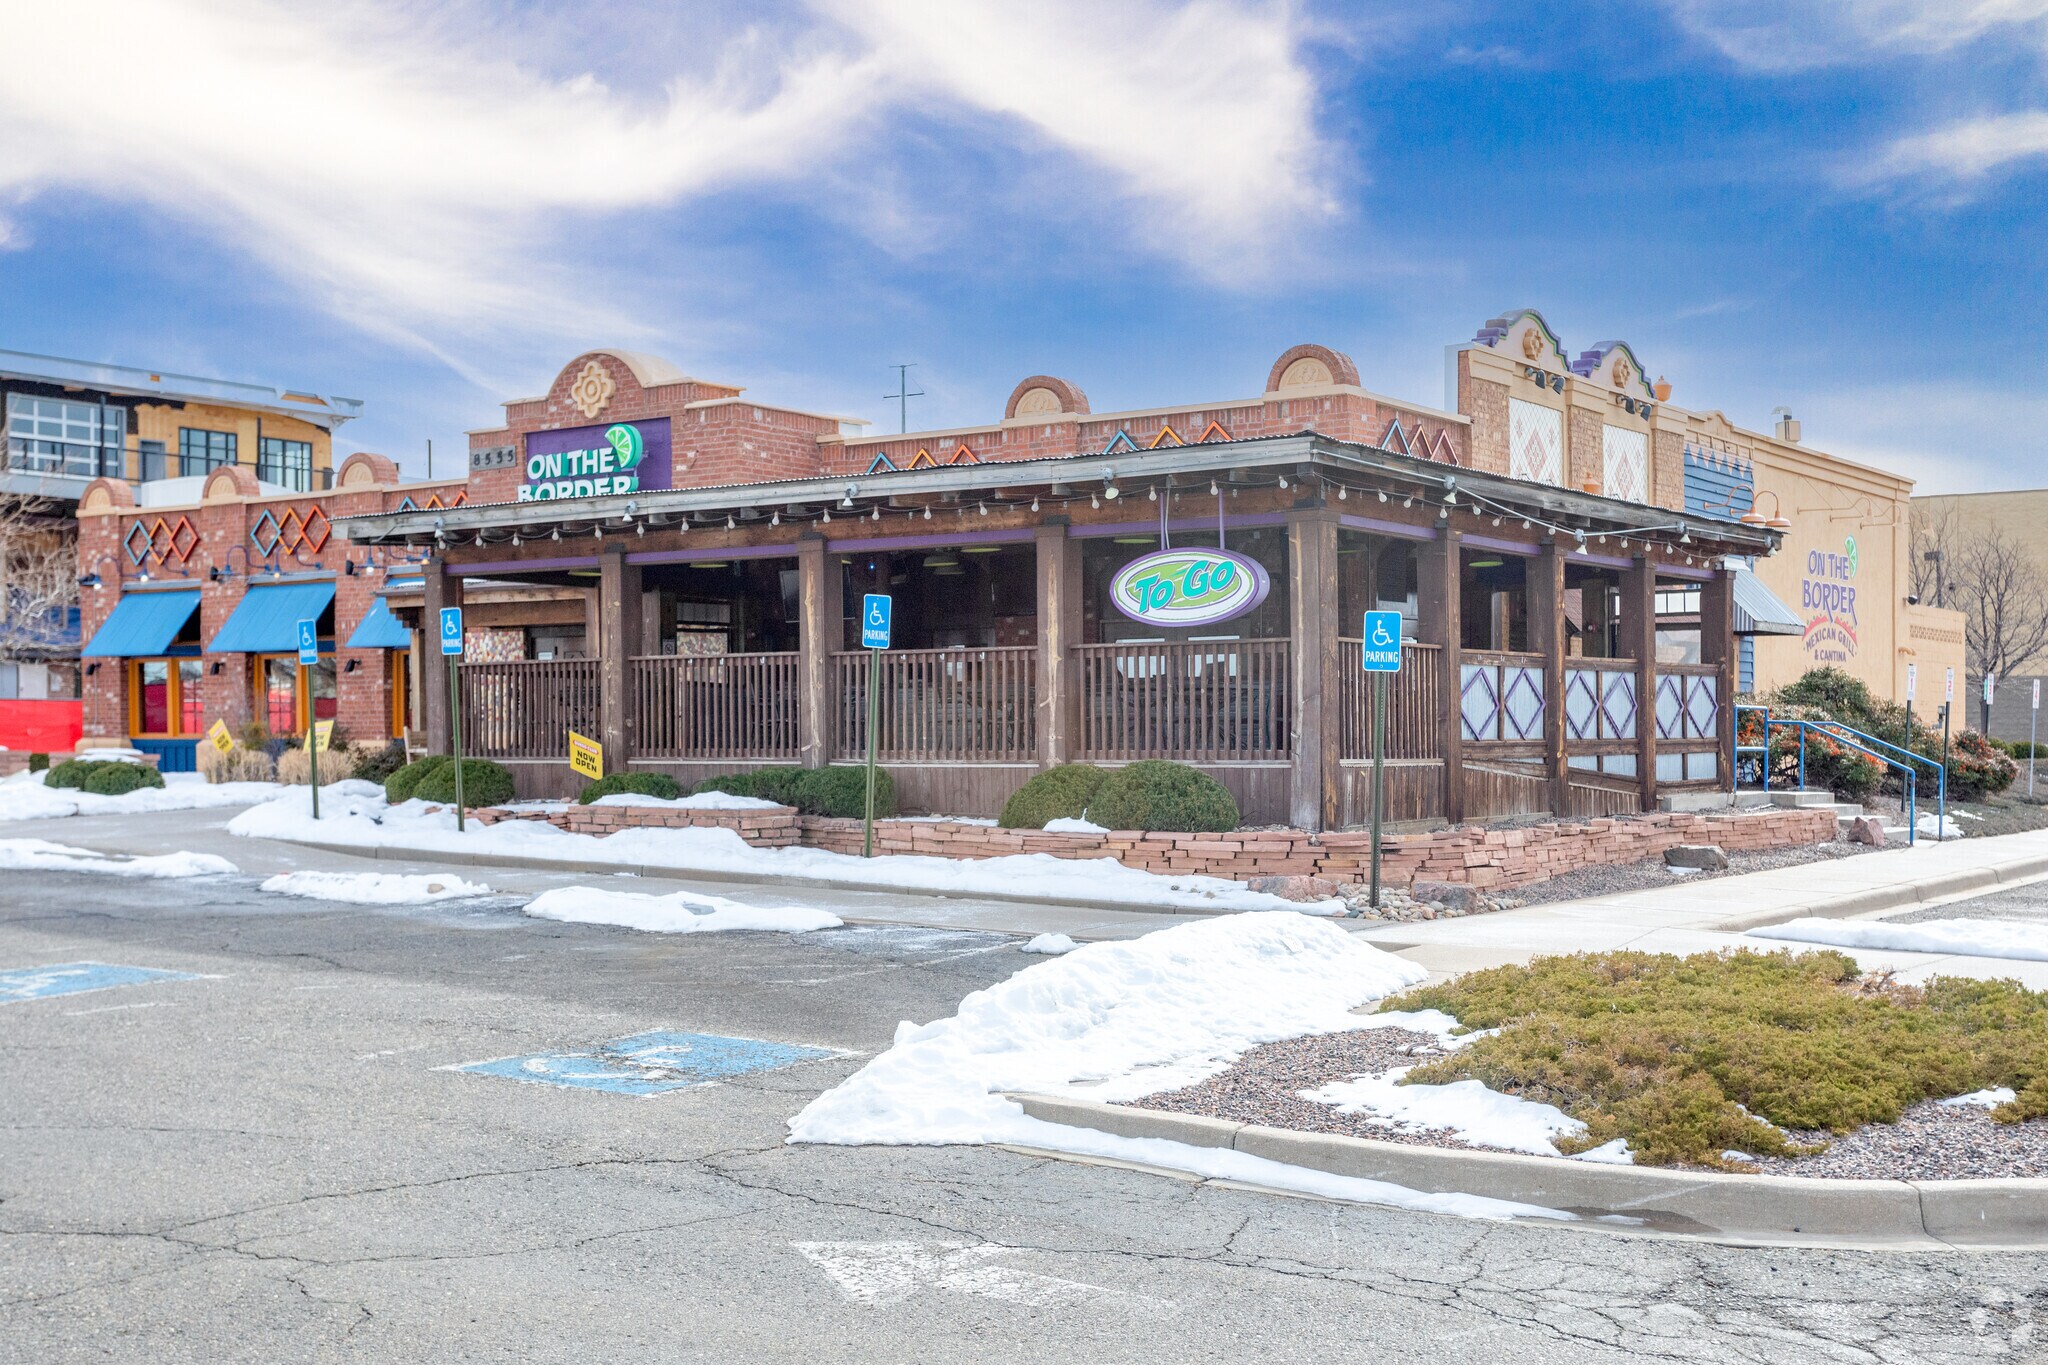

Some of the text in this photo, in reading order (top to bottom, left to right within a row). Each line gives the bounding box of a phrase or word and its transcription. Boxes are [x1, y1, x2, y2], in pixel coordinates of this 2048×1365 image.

[473, 449, 514, 466] 8555
[527, 447, 615, 480] ON THE
[1808, 549, 1849, 581] ON THE
[1802, 579, 1858, 627] BORDER
[864, 629, 888, 641] PARKING
[1806, 627, 1855, 658] MEXICAN GRILL
[1365, 650, 1399, 663] PARKING
[1814, 649, 1847, 662] & CANTINA
[575, 757, 597, 773] OPEN
[577, 750, 596, 764] NOW
